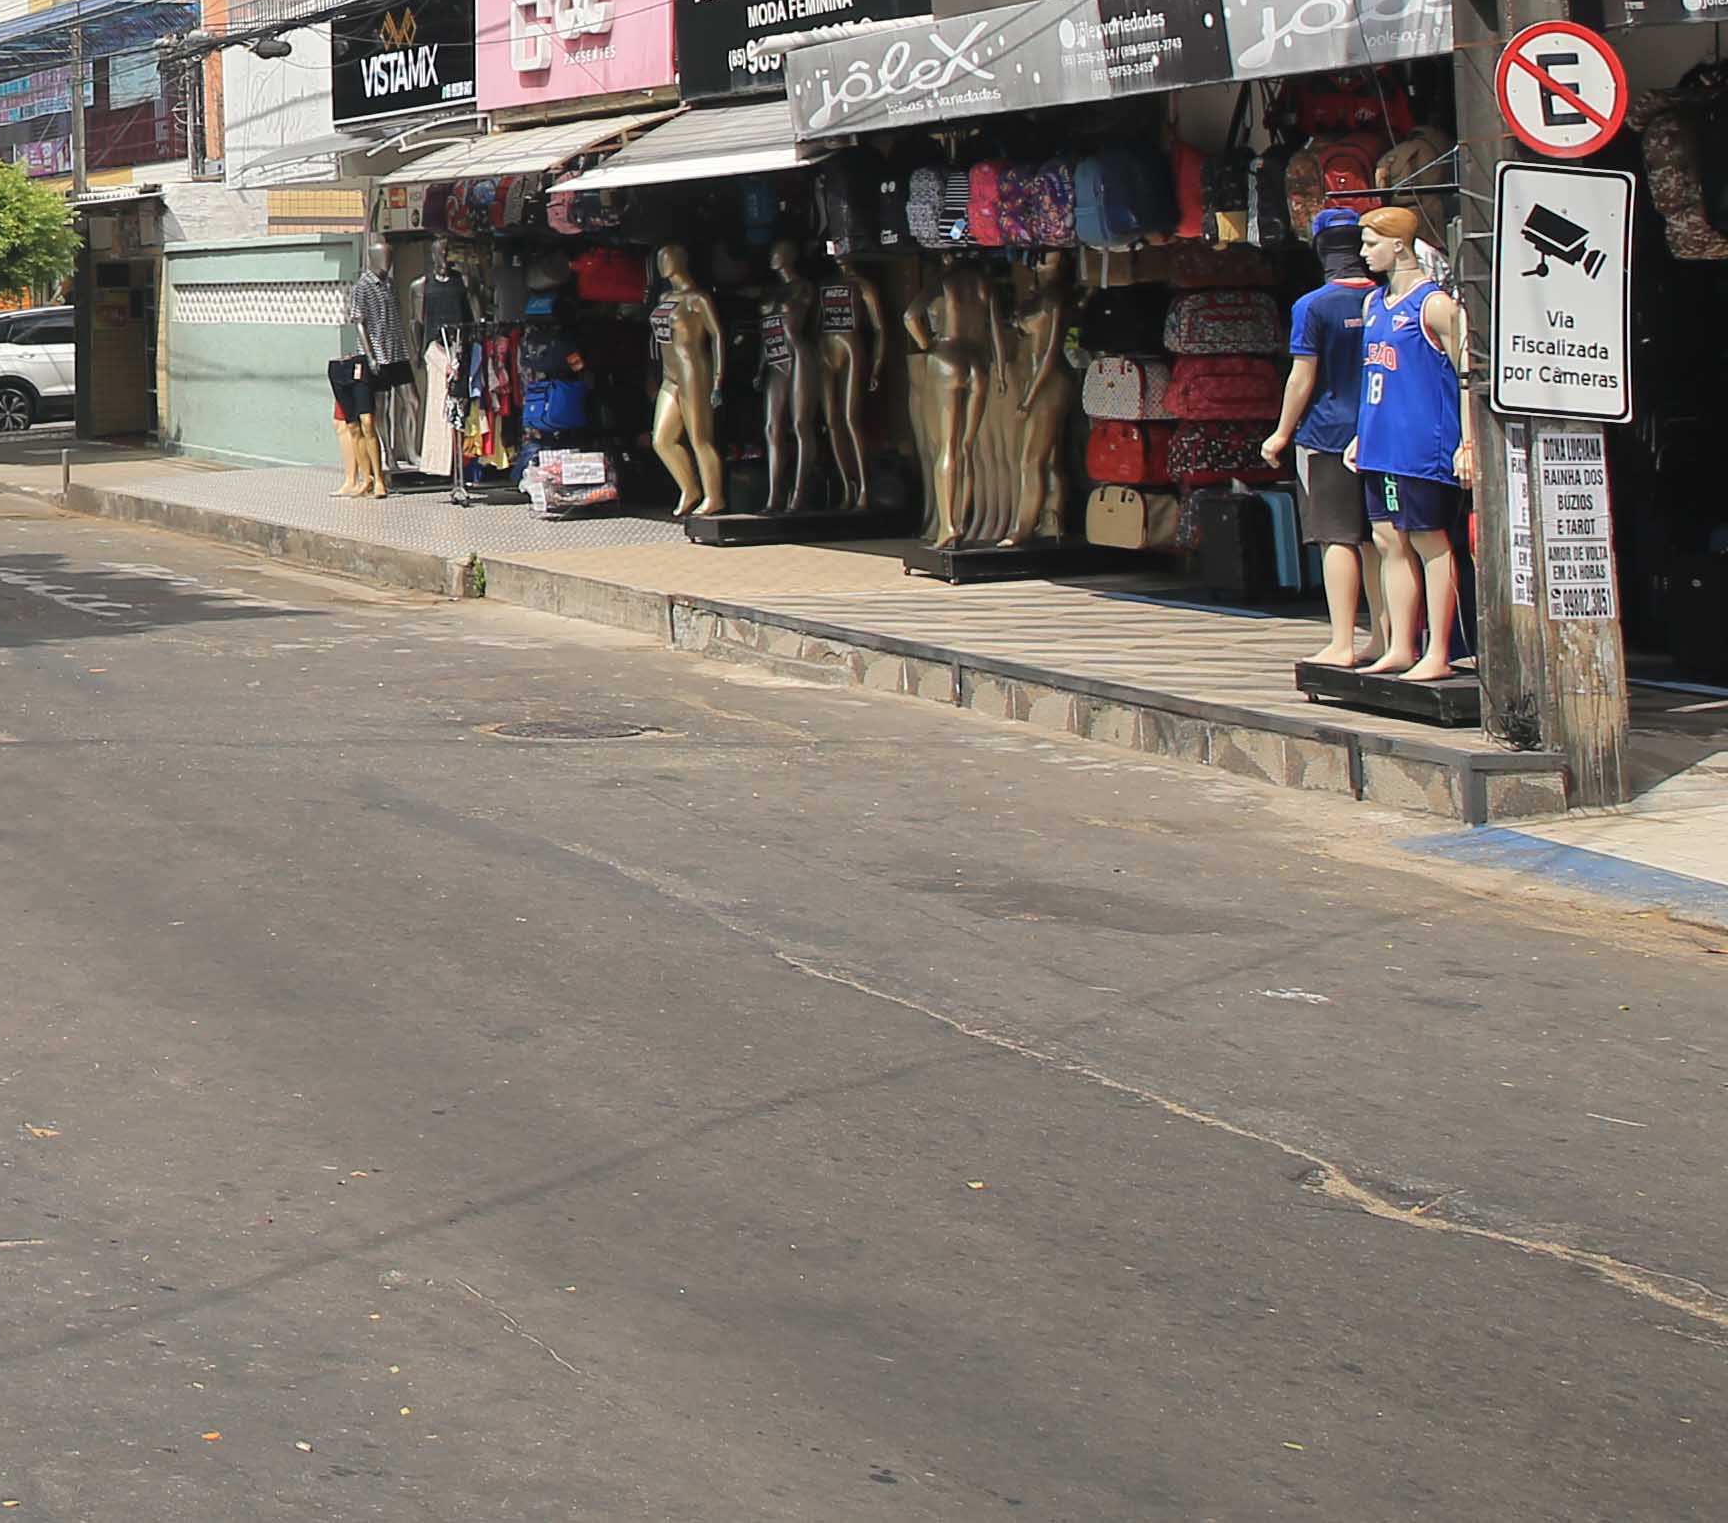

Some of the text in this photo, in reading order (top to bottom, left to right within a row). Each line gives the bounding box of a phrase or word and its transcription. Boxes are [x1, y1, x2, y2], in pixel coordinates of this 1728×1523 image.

[747, 0, 787, 28] MODA
[1364, 27, 1426, 48] bolsas
[563, 44, 617, 66] PRESENTES
[728, 47, 747, 72] (85)
[361, 43, 439, 98] VISTAMIX
[935, 87, 1002, 109] variedades
[1536, 52, 1588, 127] E
[1546, 310, 1575, 329] Via
[1512, 335, 1609, 360] Fiscalizada
[1504, 365, 1619, 389] por Câmeras
[1367, 372, 1384, 406] 18
[1567, 437, 1602, 462] LUCIANA
[1544, 468, 1604, 486] RAINHA DOS
[1557, 491, 1594, 511] BÚZIOS
[1557, 518, 1596, 535] E TAROT
[1548, 545, 1608, 562] AMOR DE VOLTA
[1553, 563, 1606, 580] EM 24 HORAS
